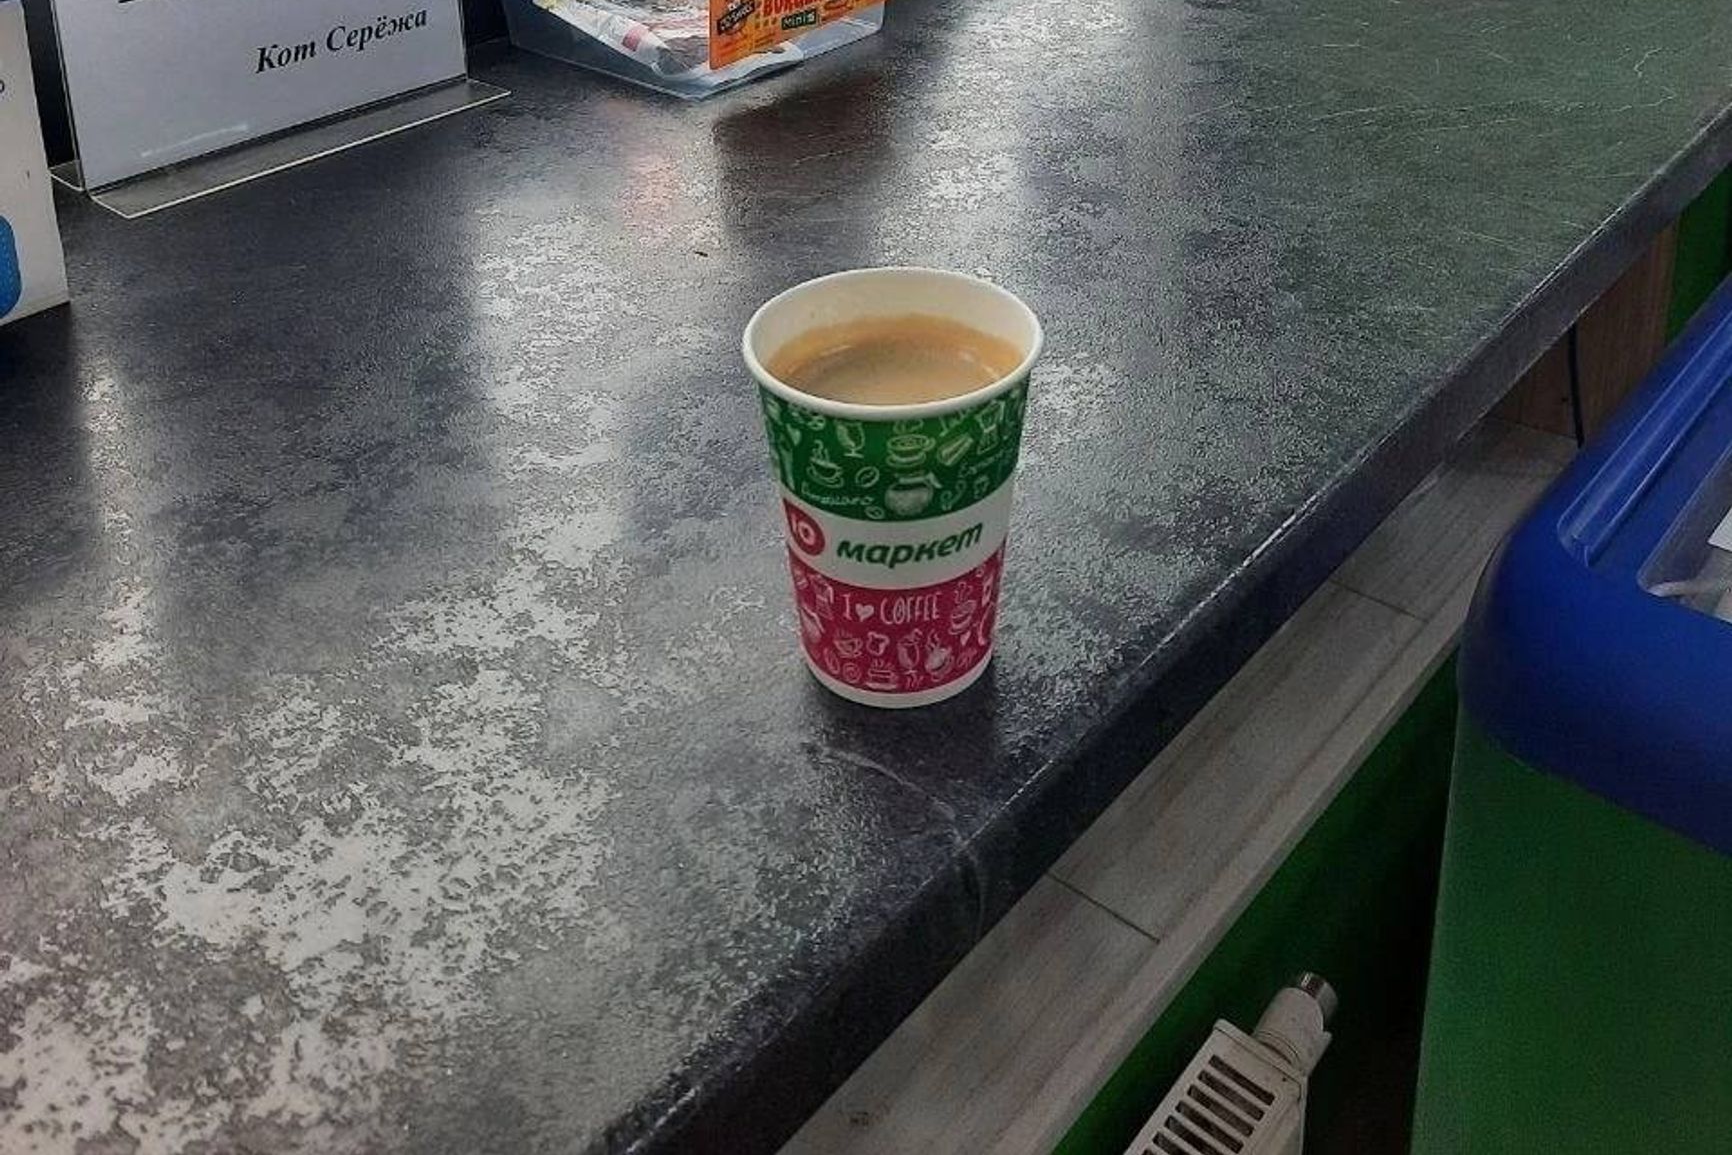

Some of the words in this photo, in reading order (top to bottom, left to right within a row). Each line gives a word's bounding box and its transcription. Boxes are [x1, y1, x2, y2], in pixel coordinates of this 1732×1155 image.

[255, 40, 317, 74] Кот
[326, 9, 428, 52] Серёжа
[836, 522, 984, 569] маркет
